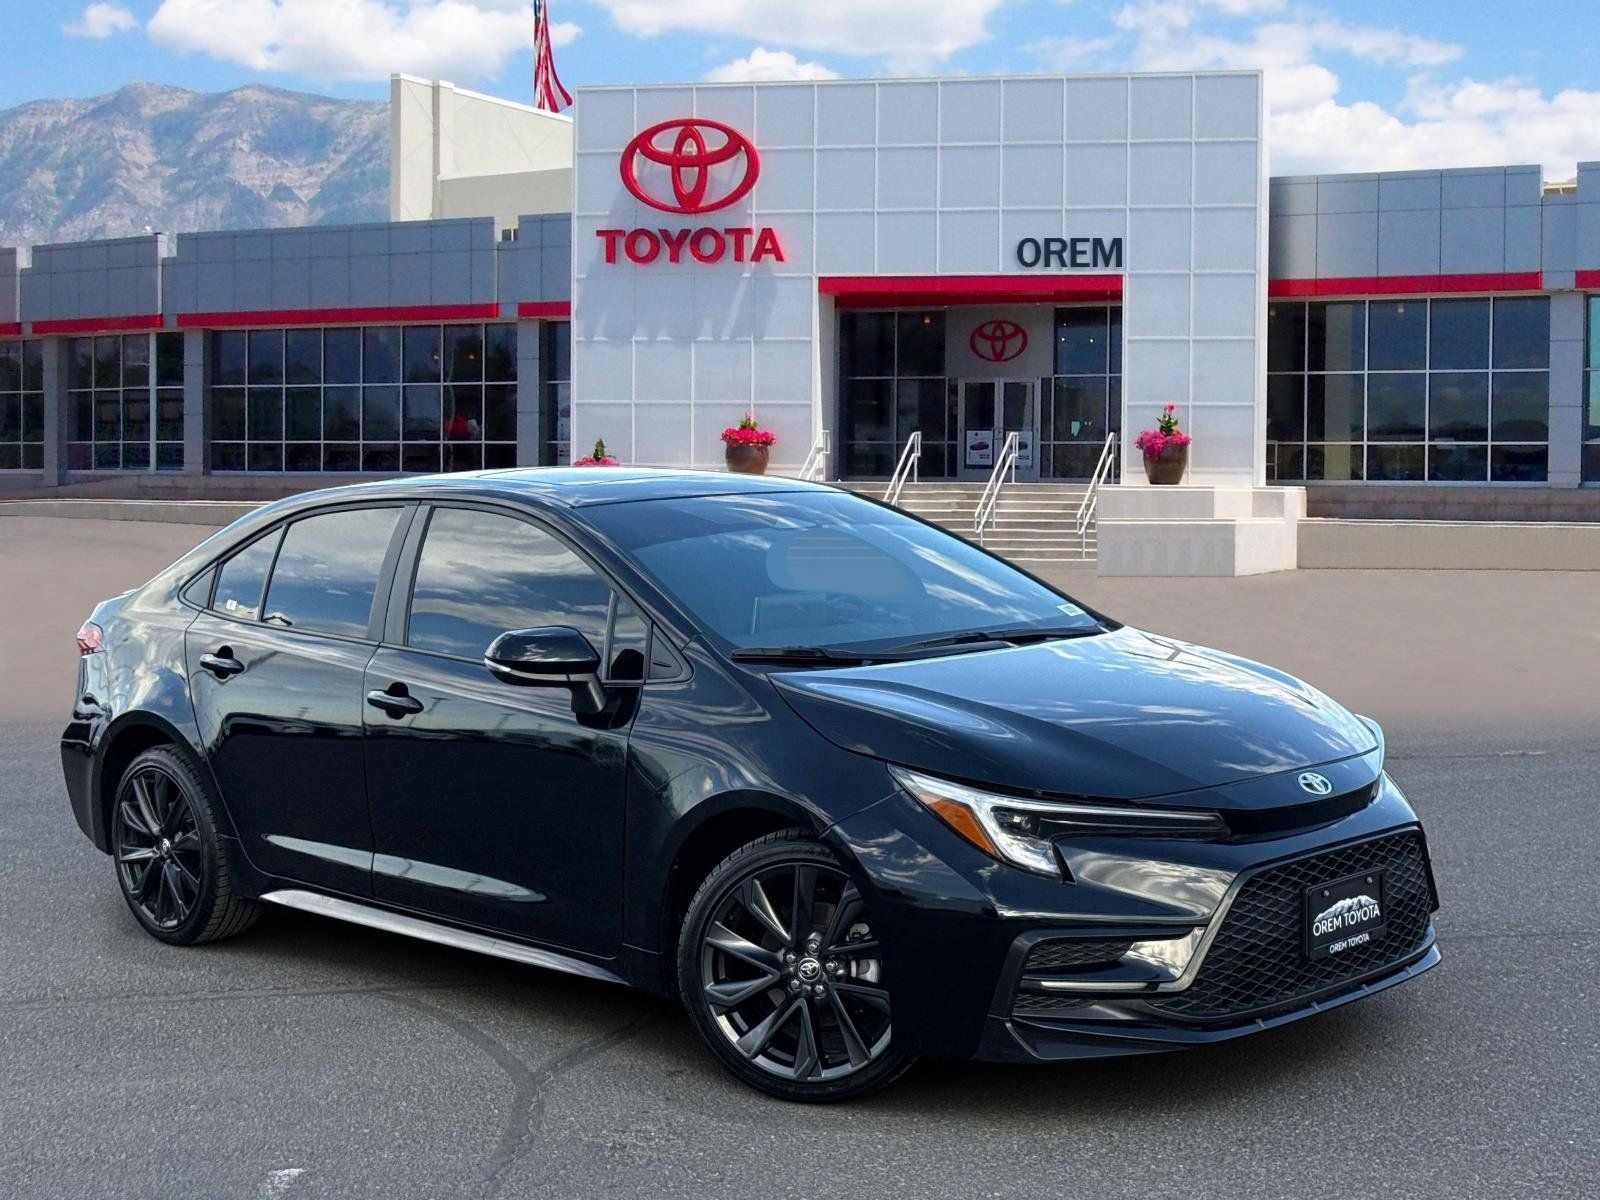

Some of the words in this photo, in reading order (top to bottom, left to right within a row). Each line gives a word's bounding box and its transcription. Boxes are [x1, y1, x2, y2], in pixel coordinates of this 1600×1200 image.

[596, 227, 784, 264] TOYOTA
[1017, 237, 1123, 268] OREM
[1313, 915, 1342, 936] OREM
[1343, 904, 1380, 926] TOYOTA
[1330, 941, 1347, 953] OREM
[1348, 933, 1369, 947] TOYOTA
